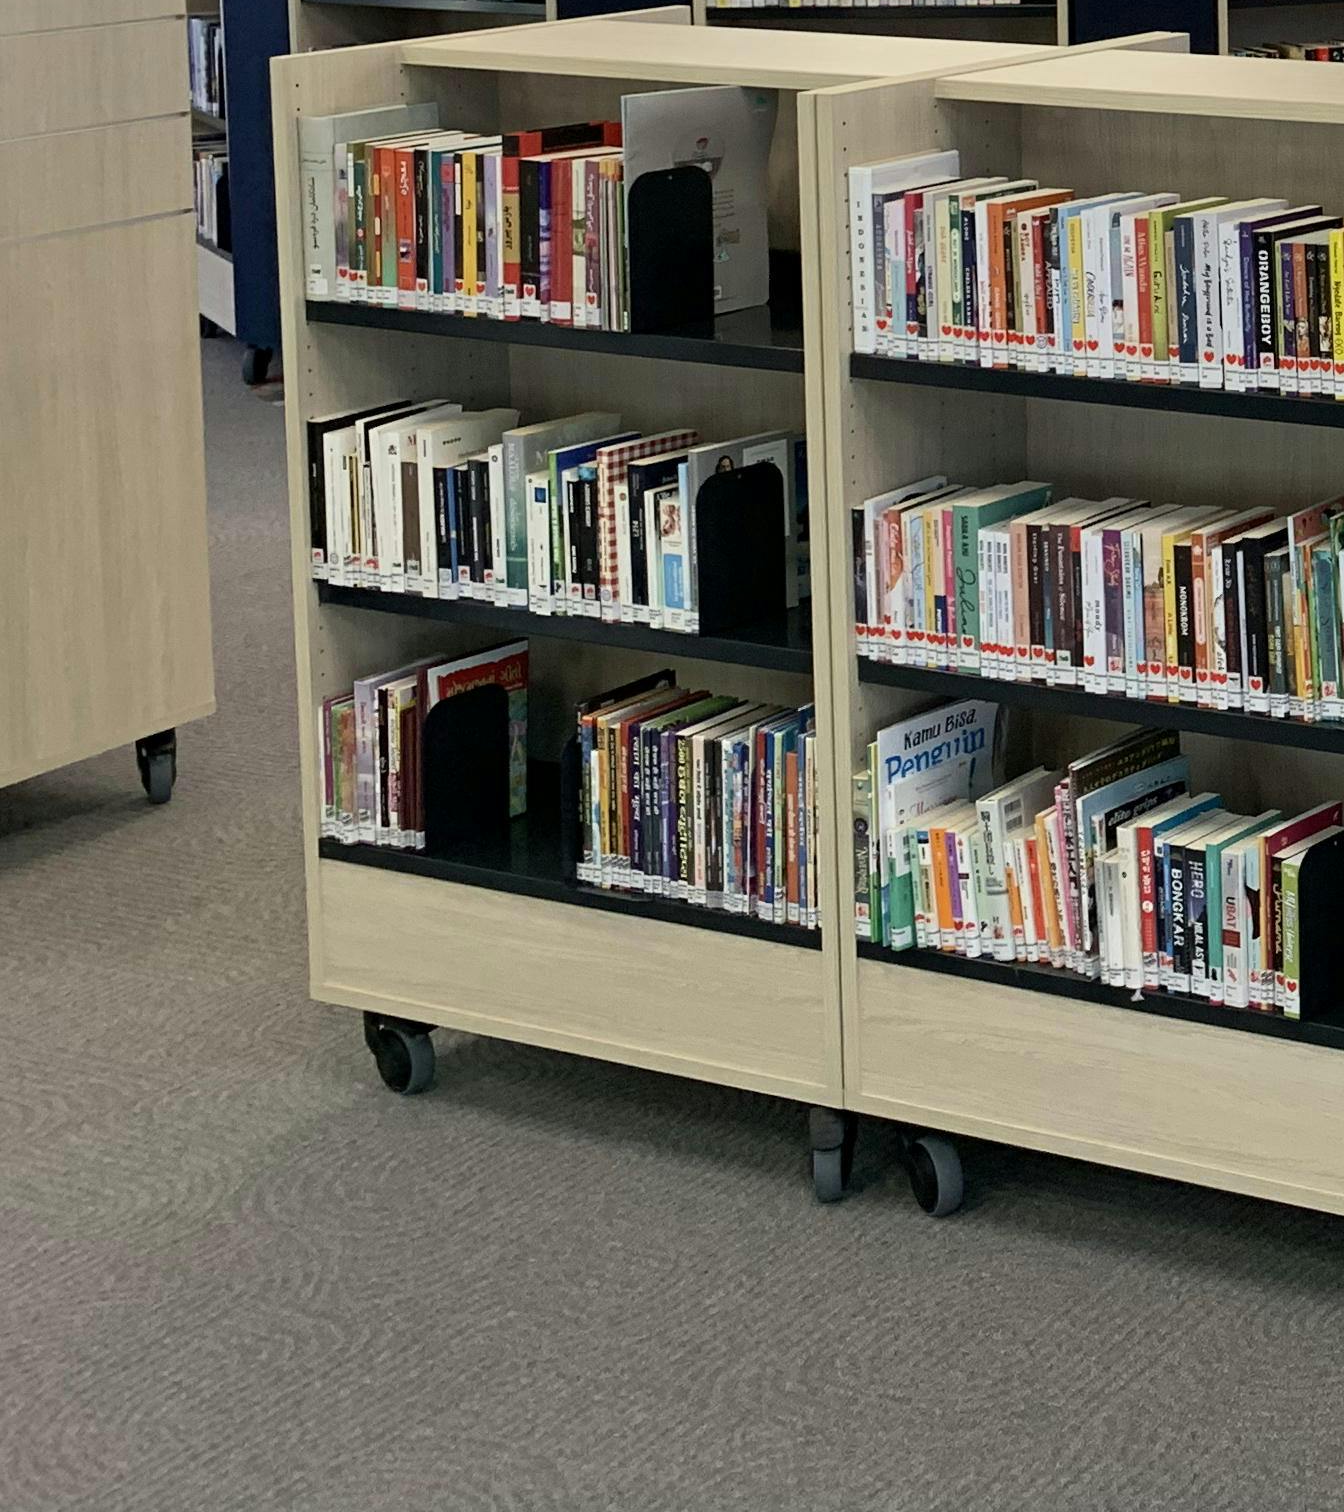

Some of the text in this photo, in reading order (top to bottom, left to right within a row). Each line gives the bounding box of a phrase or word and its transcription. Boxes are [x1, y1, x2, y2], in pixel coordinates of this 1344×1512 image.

[855, 200, 869, 334] INDONESIAN
[1258, 250, 1272, 345] ORANGEBOY
[1179, 586, 1189, 636] MONOKROM
[885, 727, 985, 785] Penguin
[903, 722, 941, 750] Kamu
[1188, 861, 1204, 899] HERO
[1171, 868, 1184, 947] BONGKAR
[1225, 896, 1236, 929] UBAT
